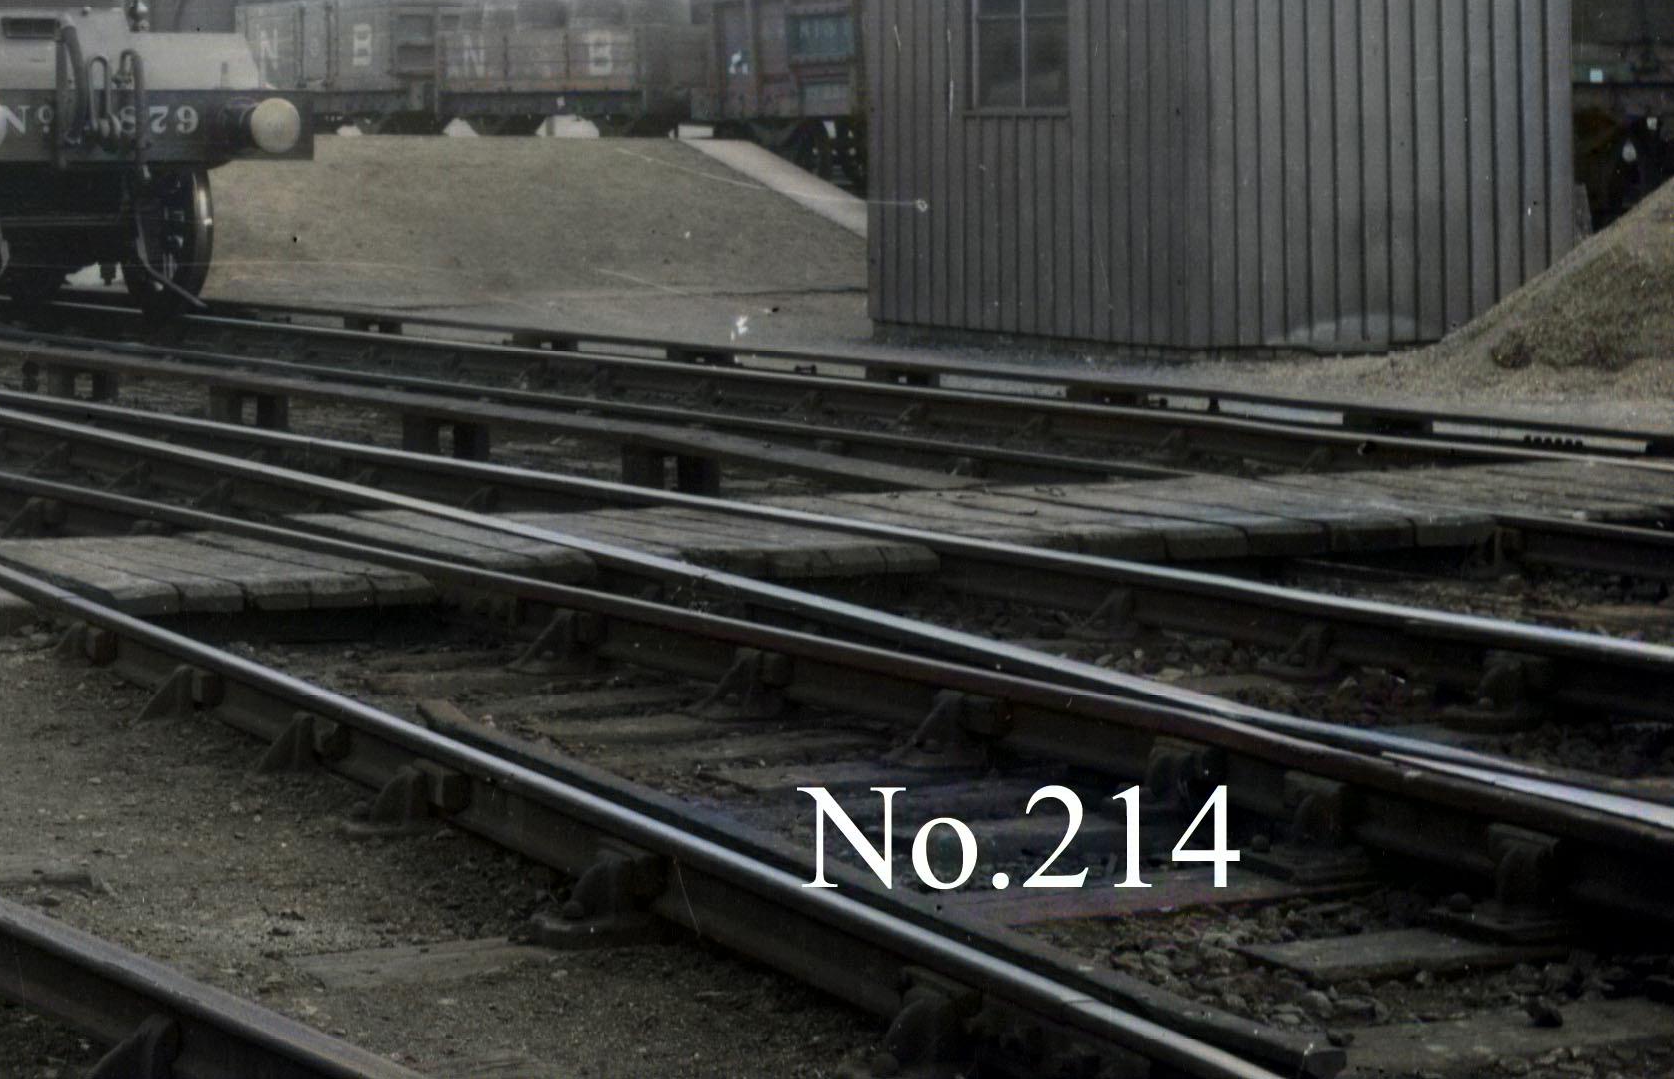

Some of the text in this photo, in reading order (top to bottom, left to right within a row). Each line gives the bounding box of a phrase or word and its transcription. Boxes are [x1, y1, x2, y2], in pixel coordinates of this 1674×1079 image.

[352, 23, 373, 66] B
[461, 30, 614, 78] N B
